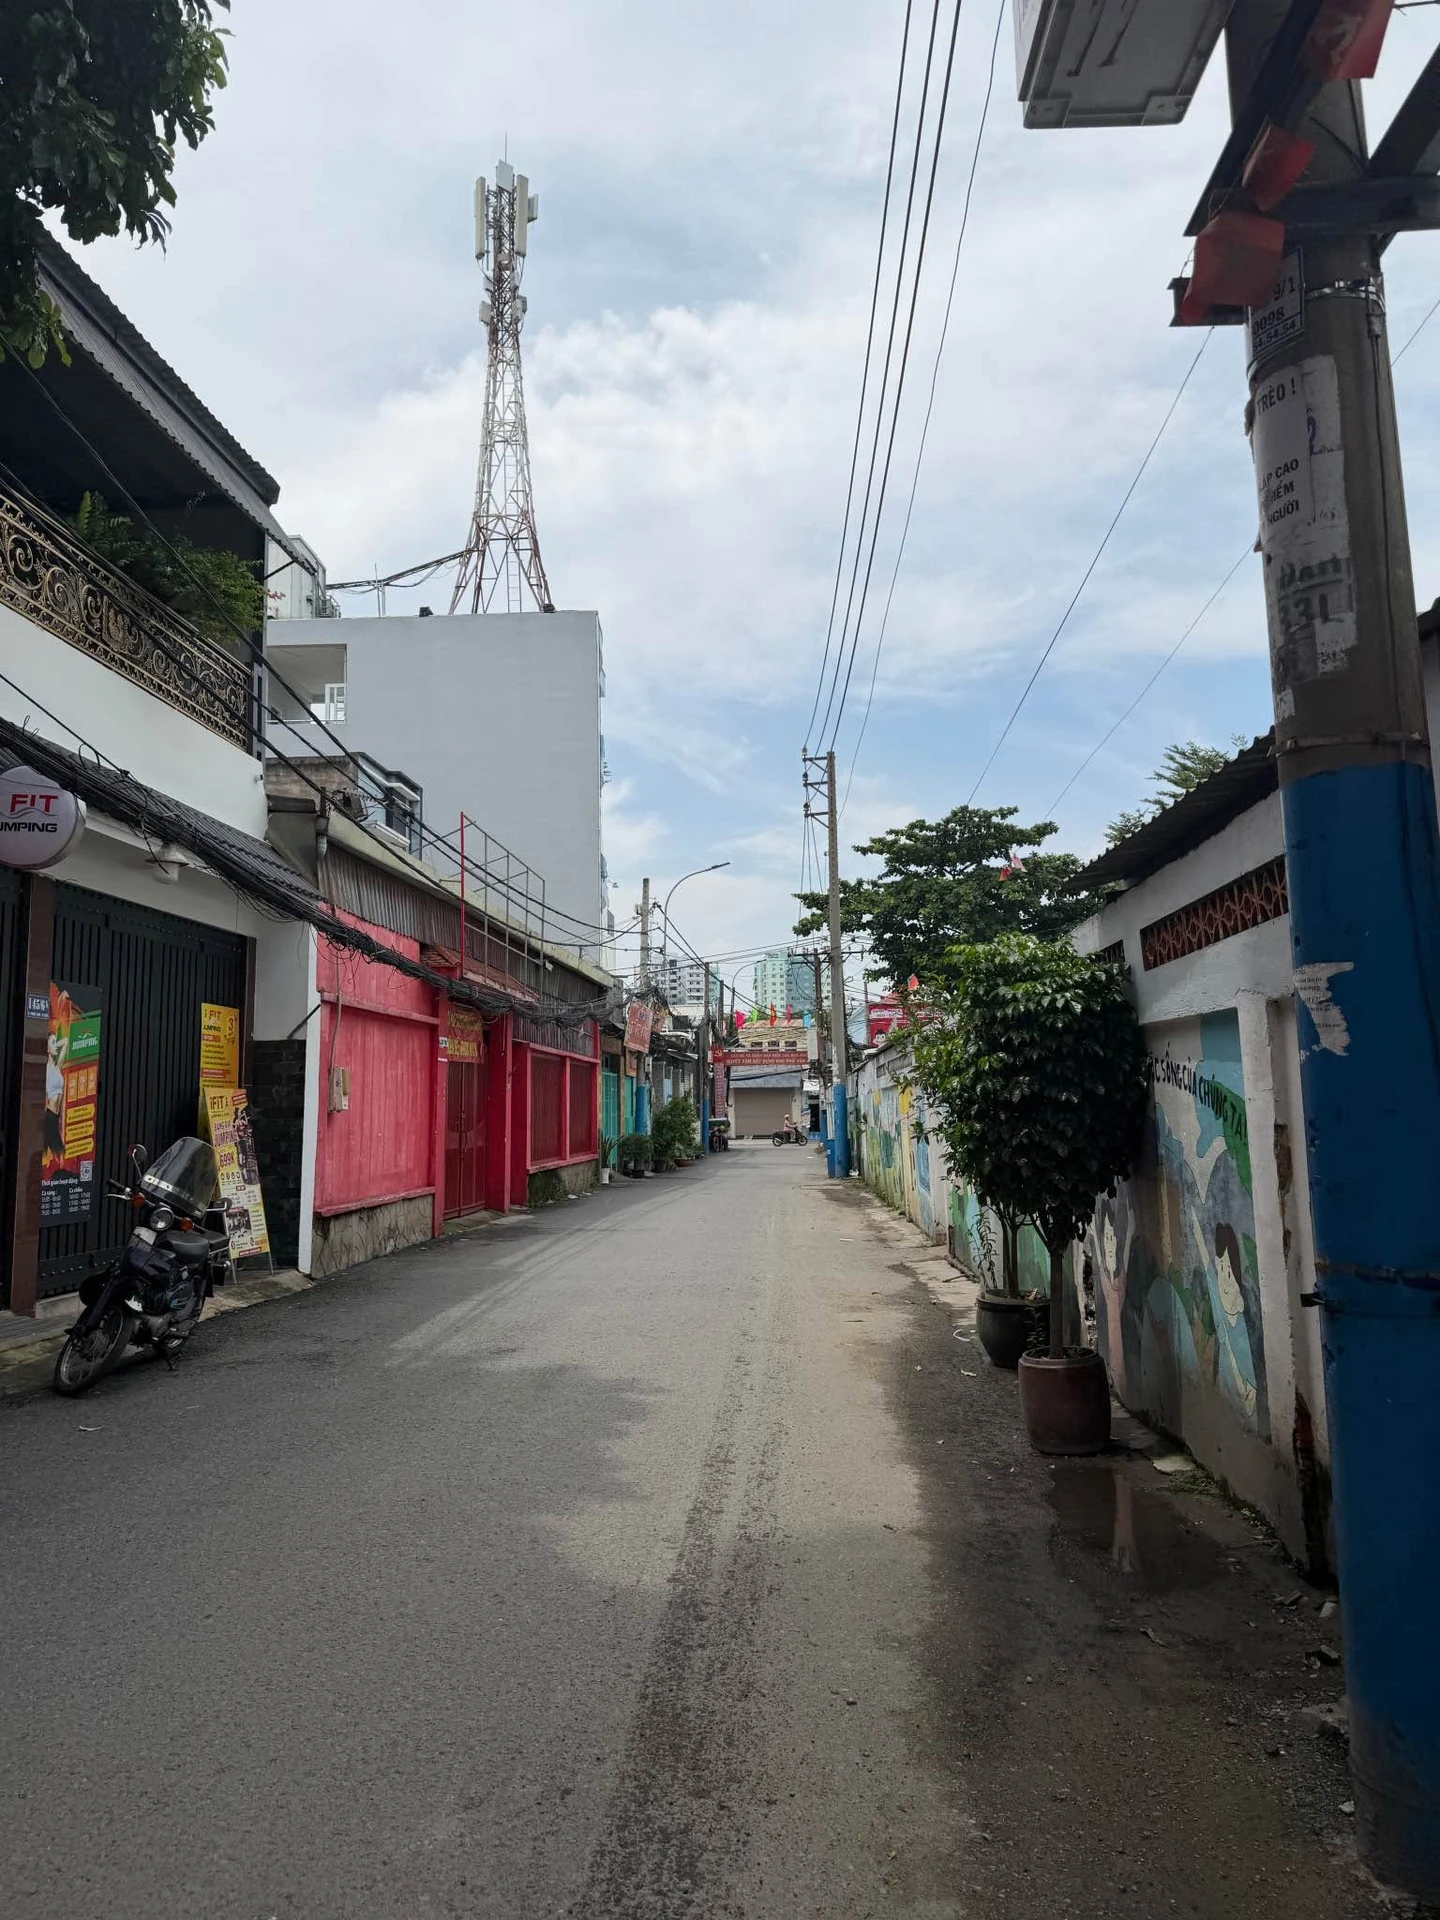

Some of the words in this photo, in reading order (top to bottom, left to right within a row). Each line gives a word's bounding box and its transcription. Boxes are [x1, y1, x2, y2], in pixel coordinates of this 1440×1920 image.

[1275, 458, 1299, 479] CAO
[10, 793, 59, 813] FIT
[1160, 1041, 1182, 1090] SỐNG
[1182, 1056, 1197, 1098] CỦA
[1199, 1073, 1228, 1122] CHÚNG
